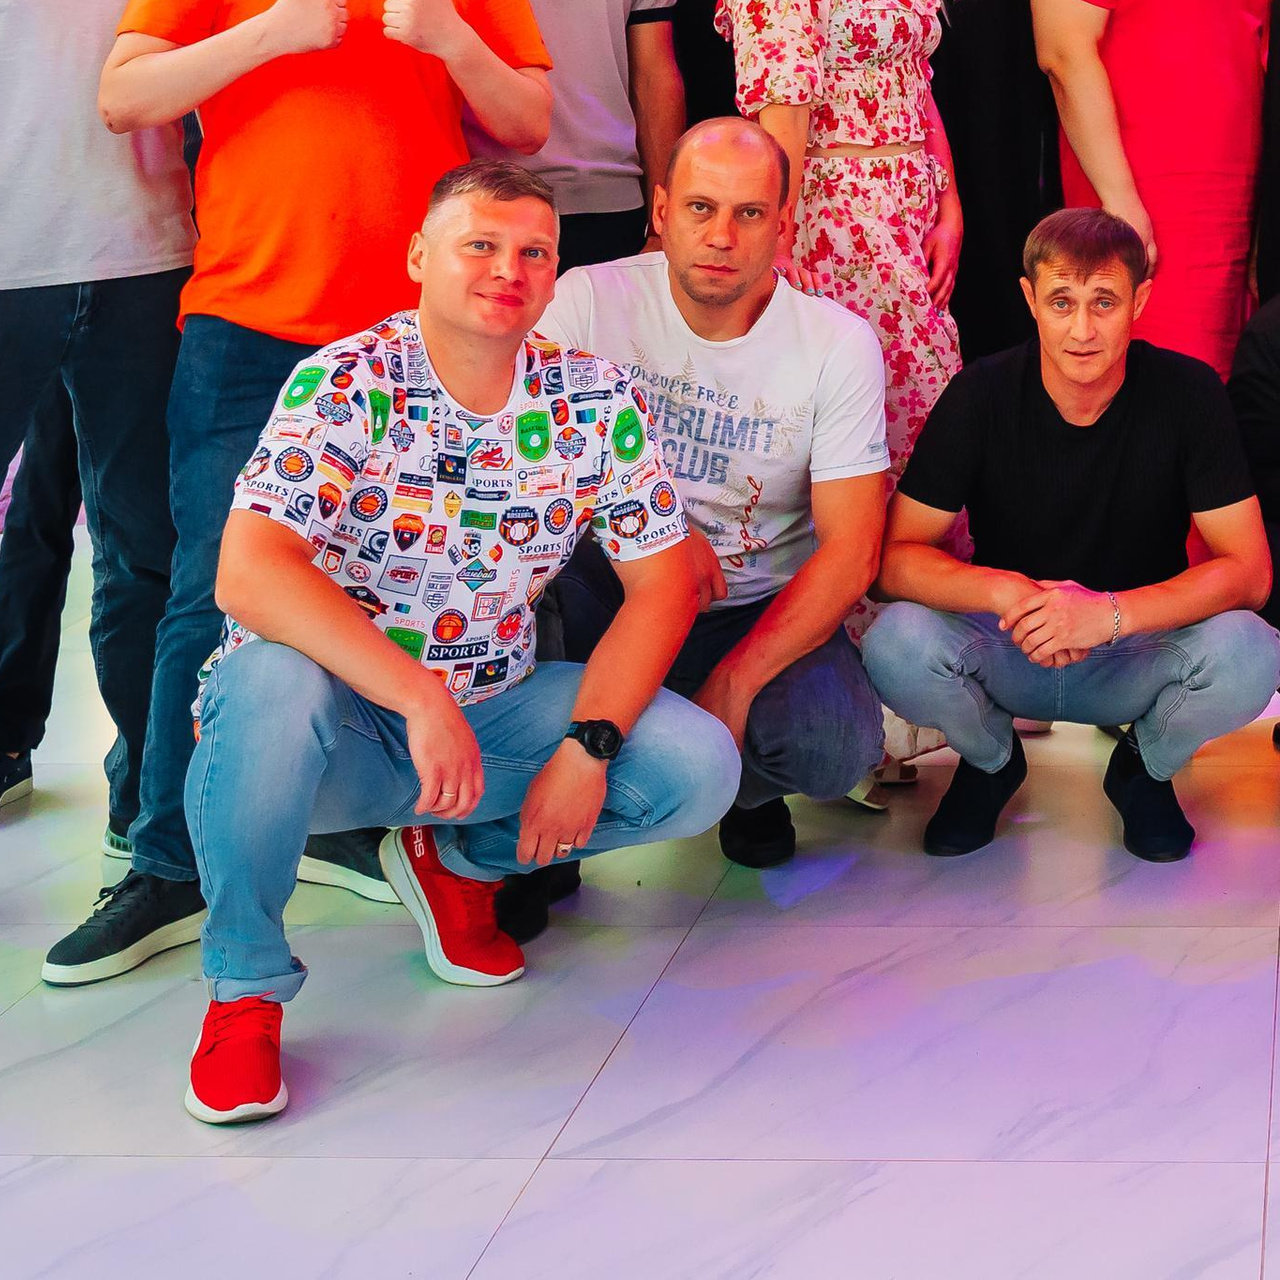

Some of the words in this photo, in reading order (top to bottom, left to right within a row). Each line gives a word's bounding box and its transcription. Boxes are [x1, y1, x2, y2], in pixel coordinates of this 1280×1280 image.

[697, 386, 739, 411] FREE
[245, 480, 290, 497] SPORTS
[635, 521, 677, 545] SPORTS
[518, 542, 561, 554] SPORTS
[504, 568, 520, 605] SPORTS
[394, 616, 425, 629] SPORTS
[430, 643, 486, 658] SPORTS
